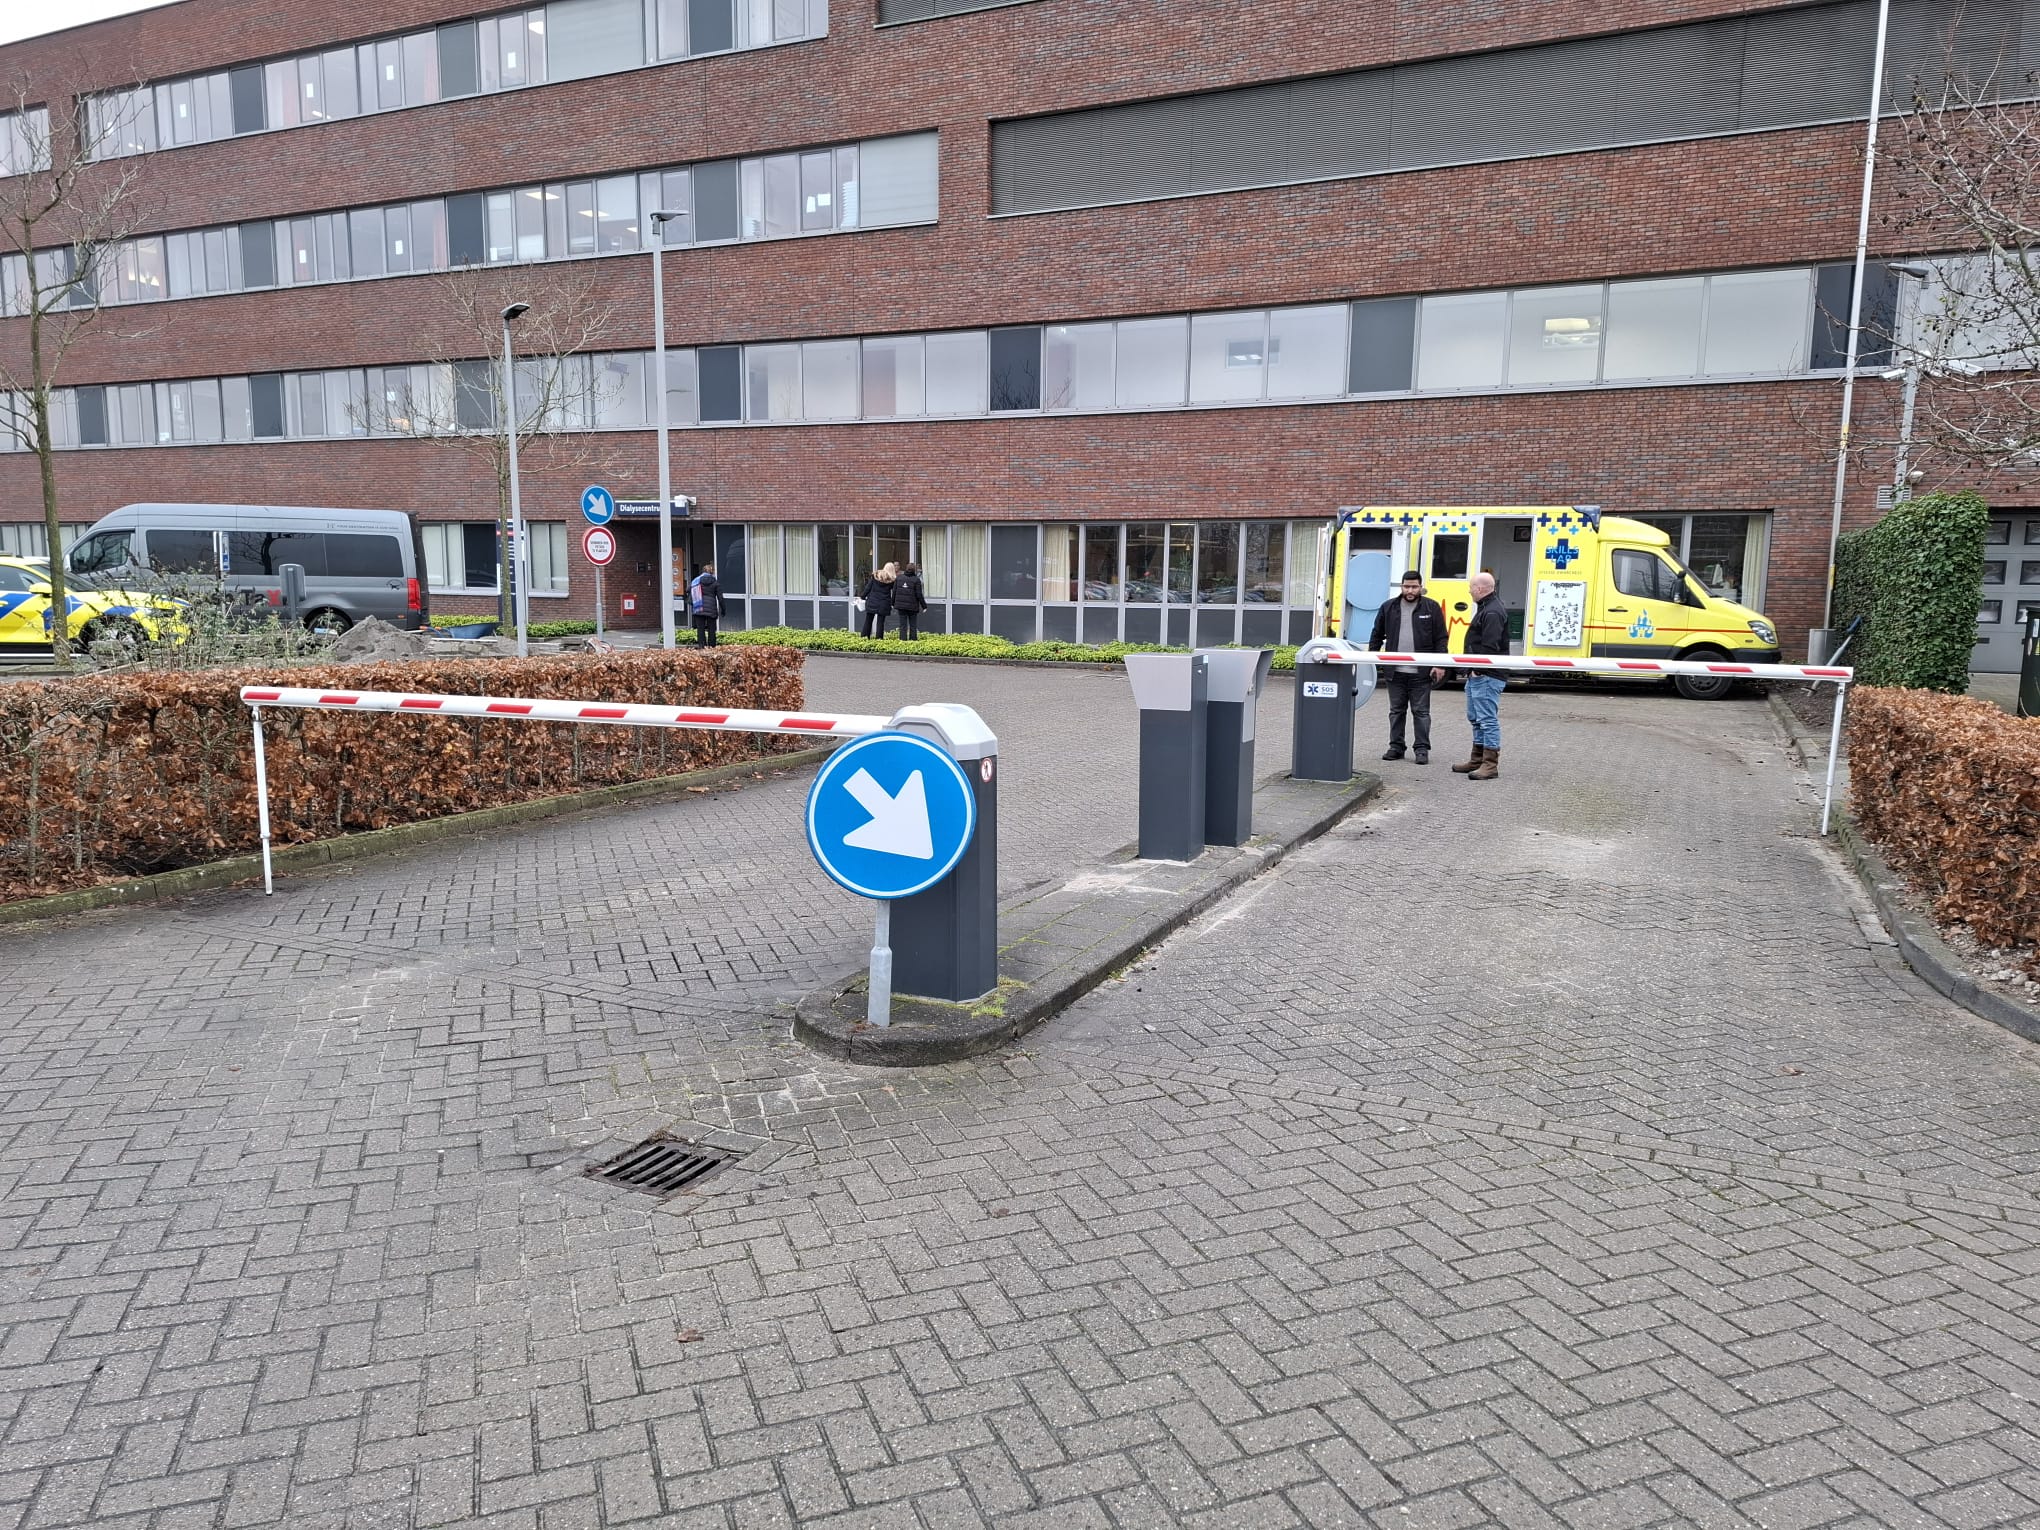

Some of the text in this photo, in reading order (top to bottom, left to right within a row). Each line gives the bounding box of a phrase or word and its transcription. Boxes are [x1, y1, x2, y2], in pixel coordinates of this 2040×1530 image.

[620, 504, 661, 513] Dialysecentru
[1546, 546, 1579, 554] SKILLS
[1551, 554, 1572, 563] LAB
